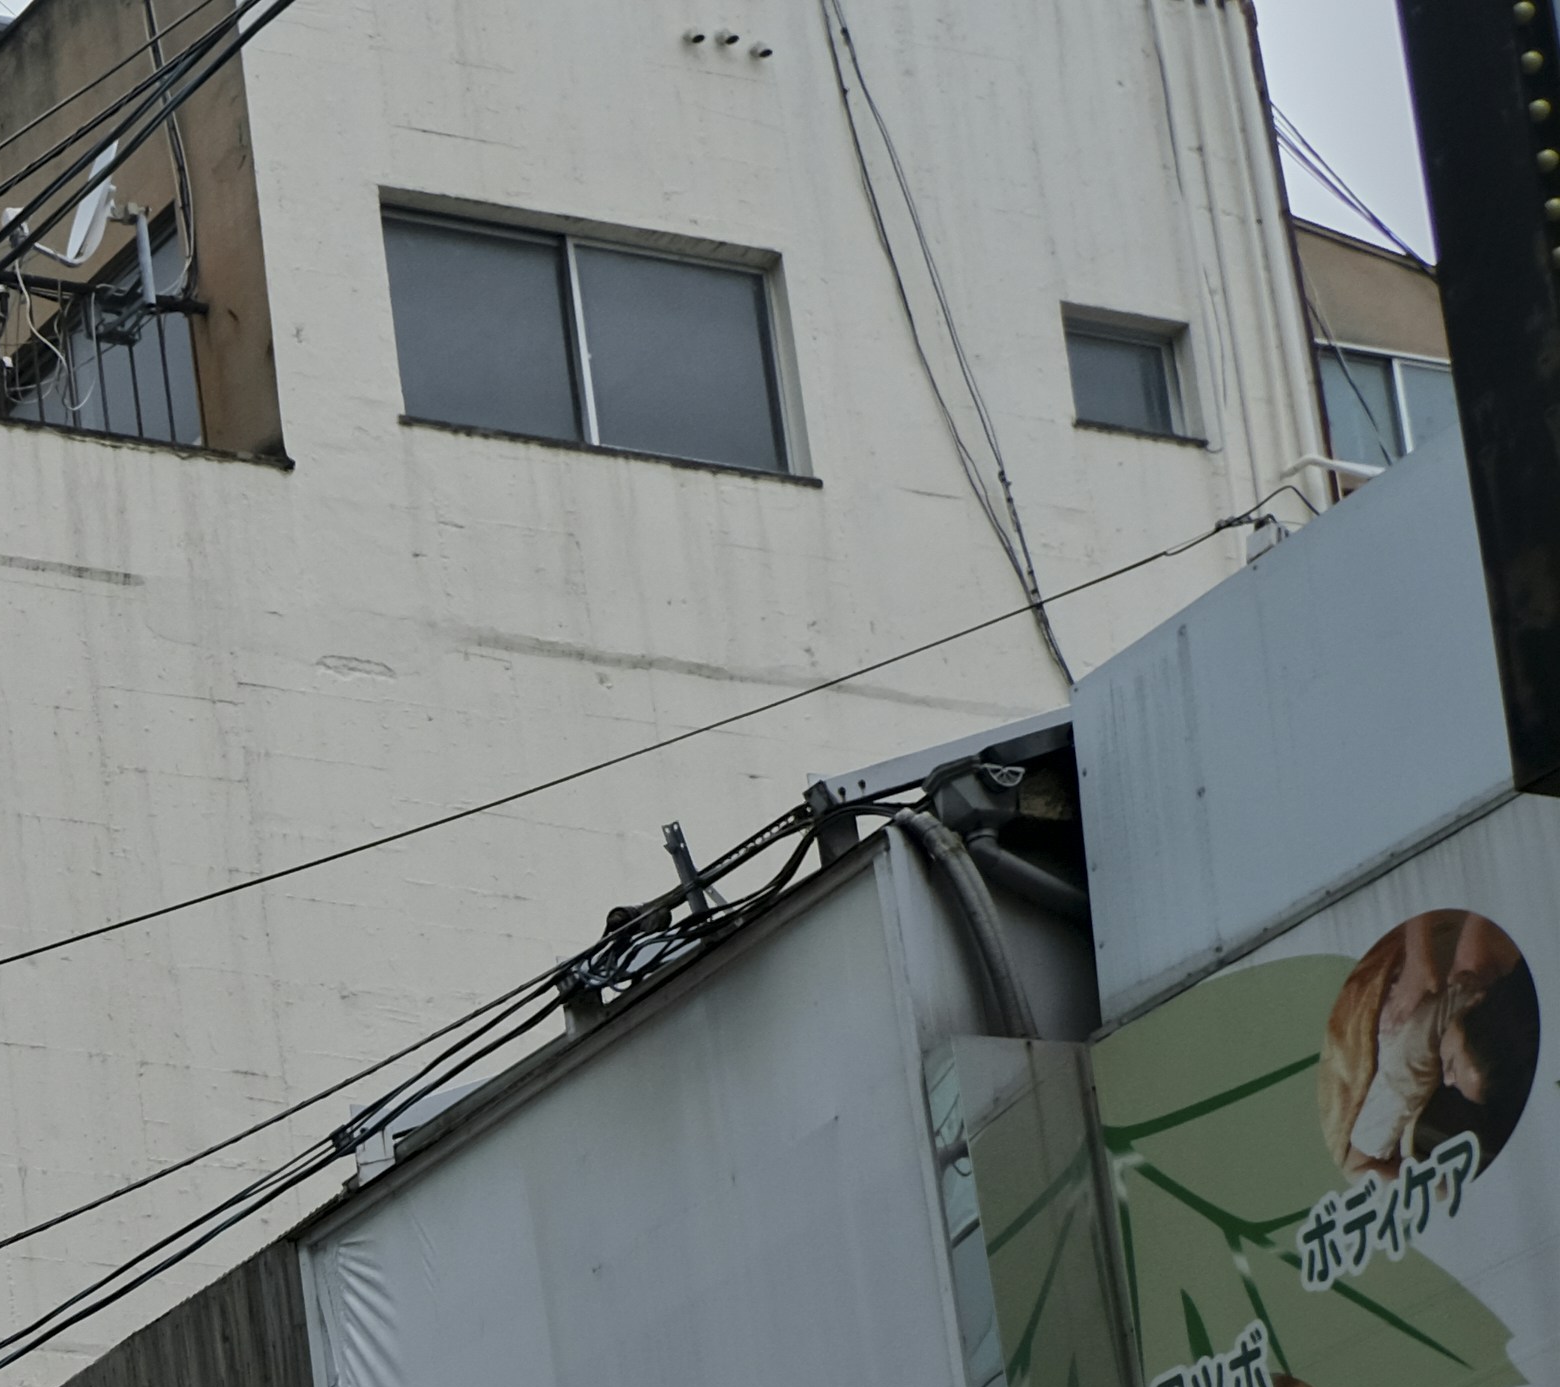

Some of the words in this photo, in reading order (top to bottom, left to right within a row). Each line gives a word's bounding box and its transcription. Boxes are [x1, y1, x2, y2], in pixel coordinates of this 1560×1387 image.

[1302, 1138, 1478, 1284] ボディケア
